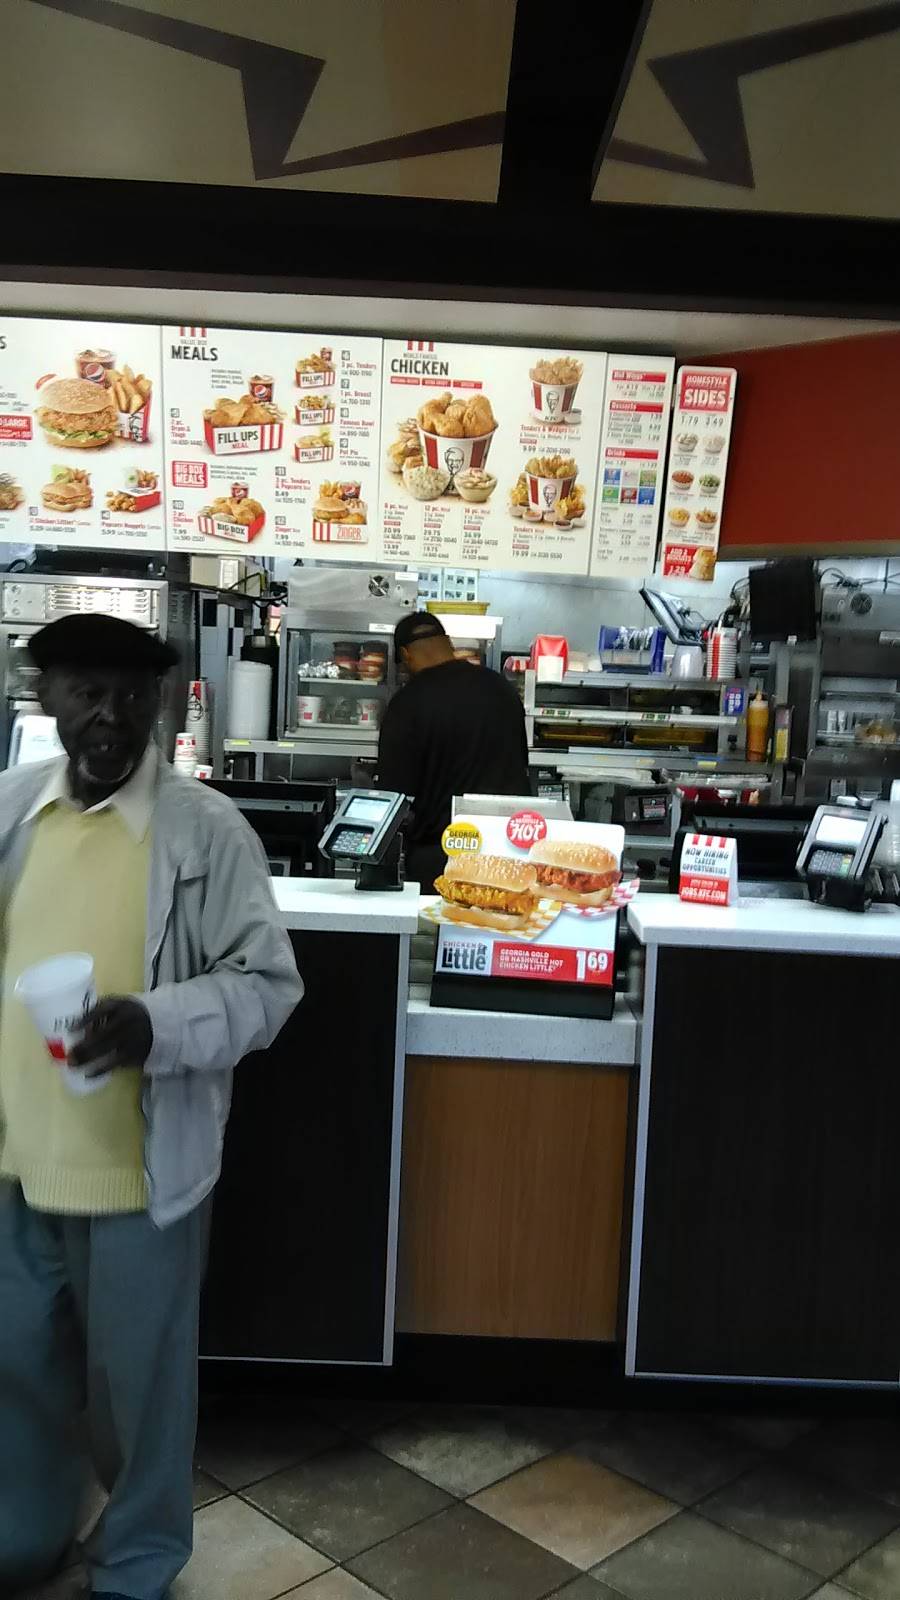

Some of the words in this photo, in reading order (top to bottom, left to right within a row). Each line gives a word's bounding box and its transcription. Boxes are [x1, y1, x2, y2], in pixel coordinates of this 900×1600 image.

[171, 345, 218, 362] MEALS
[391, 358, 450, 376] CHICKEN
[685, 375, 728, 386] HOMESTYLE
[684, 388, 726, 407] SIDES
[218, 431, 240, 445] FILL
[240, 430, 259, 443] UPS
[175, 464, 189, 474] BIG
[189, 464, 204, 475] BOX
[175, 473, 205, 485] MEALS
[217, 523, 230, 532] BIG
[230, 525, 246, 535] BOX
[337, 525, 362, 541] ZINGER
[448, 828, 480, 839] GEORGIA
[509, 821, 545, 841] HOT
[445, 837, 479, 851] GOLD
[685, 847, 702, 857] NOW
[703, 850, 729, 860] HIRING
[694, 857, 716, 866] CAREER
[682, 863, 727, 874] OPPORTUNITIES
[680, 886, 726, 901] JOBS.KFC.COM
[442, 940, 478, 949] CHICKEN
[441, 944, 487, 971] Little
[500, 948, 530, 957] GEORGIA
[531, 951, 550, 959] GOLD
[499, 961, 529, 970] CHICKEN
[500, 955, 510, 963] OR
[511, 956, 549, 965] NASHVILLE
[549, 959, 564, 967] HOT
